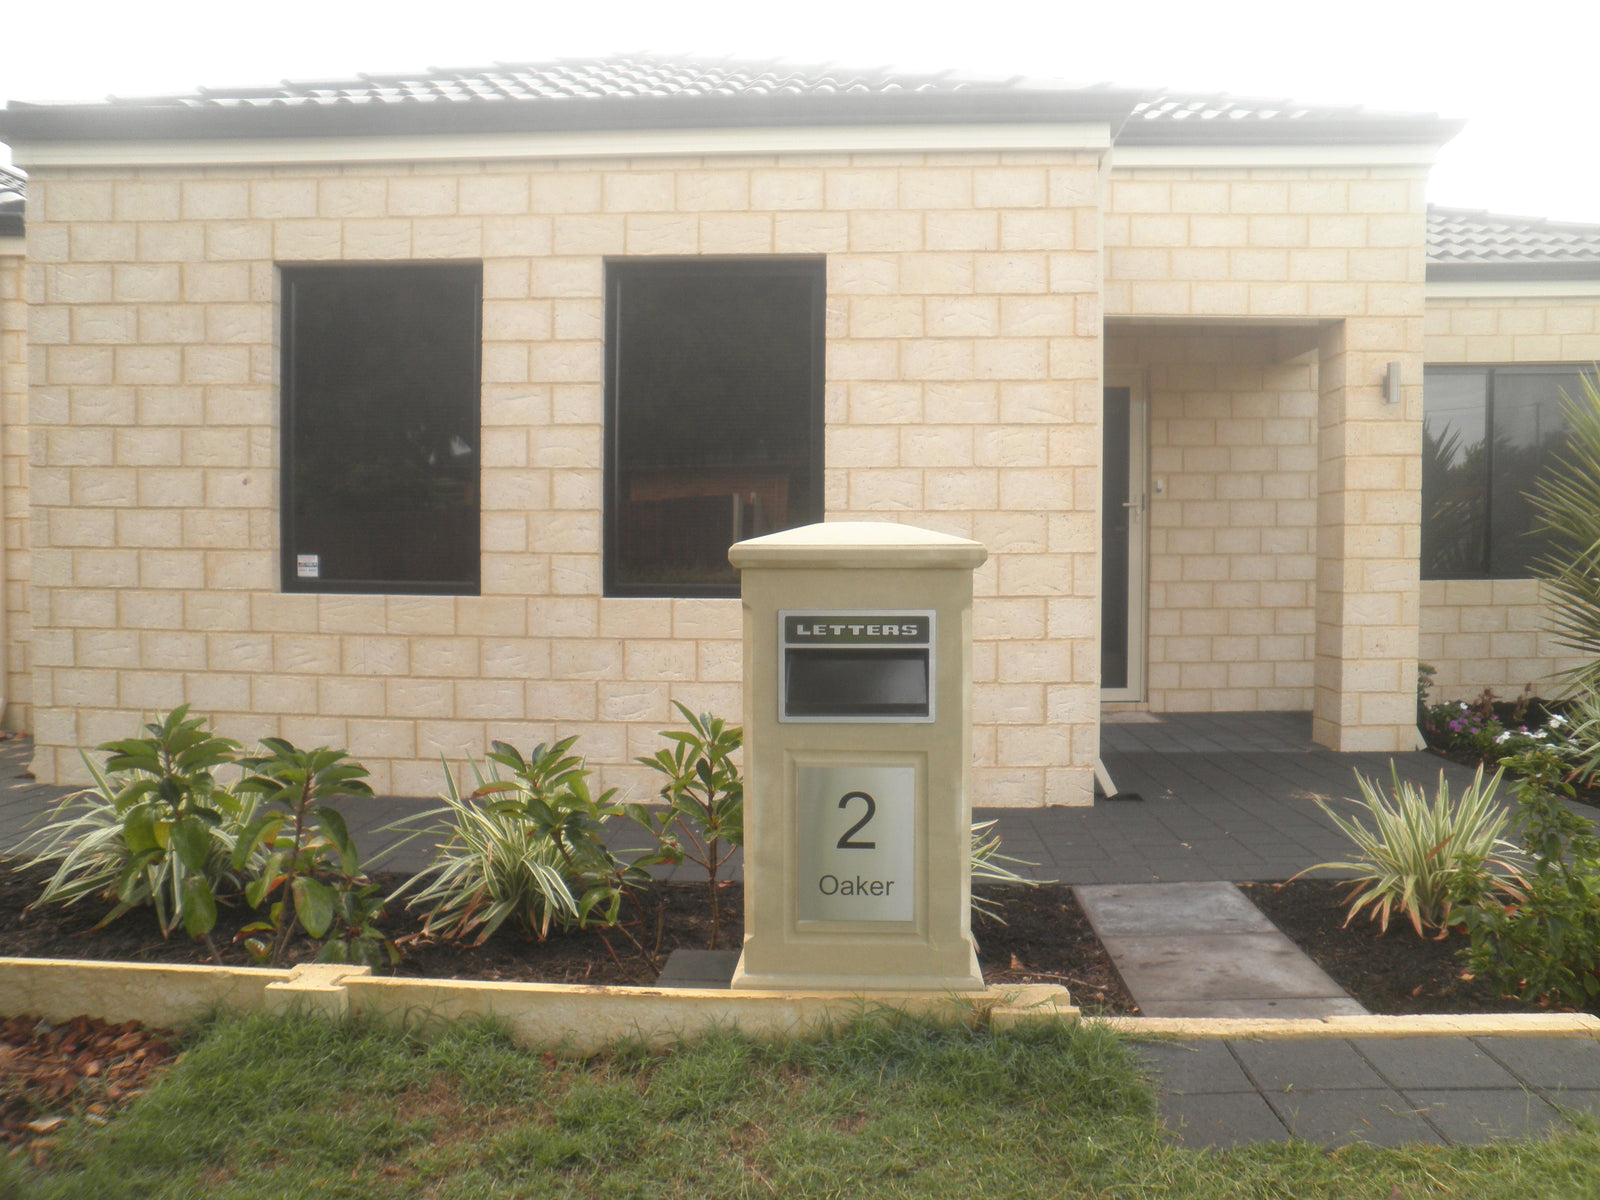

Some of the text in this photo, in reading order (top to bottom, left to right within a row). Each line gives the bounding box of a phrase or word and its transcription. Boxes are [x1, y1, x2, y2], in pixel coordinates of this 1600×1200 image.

[796, 624, 918, 636] LETTERS
[836, 791, 876, 849] 2
[819, 874, 895, 896] Oaker
